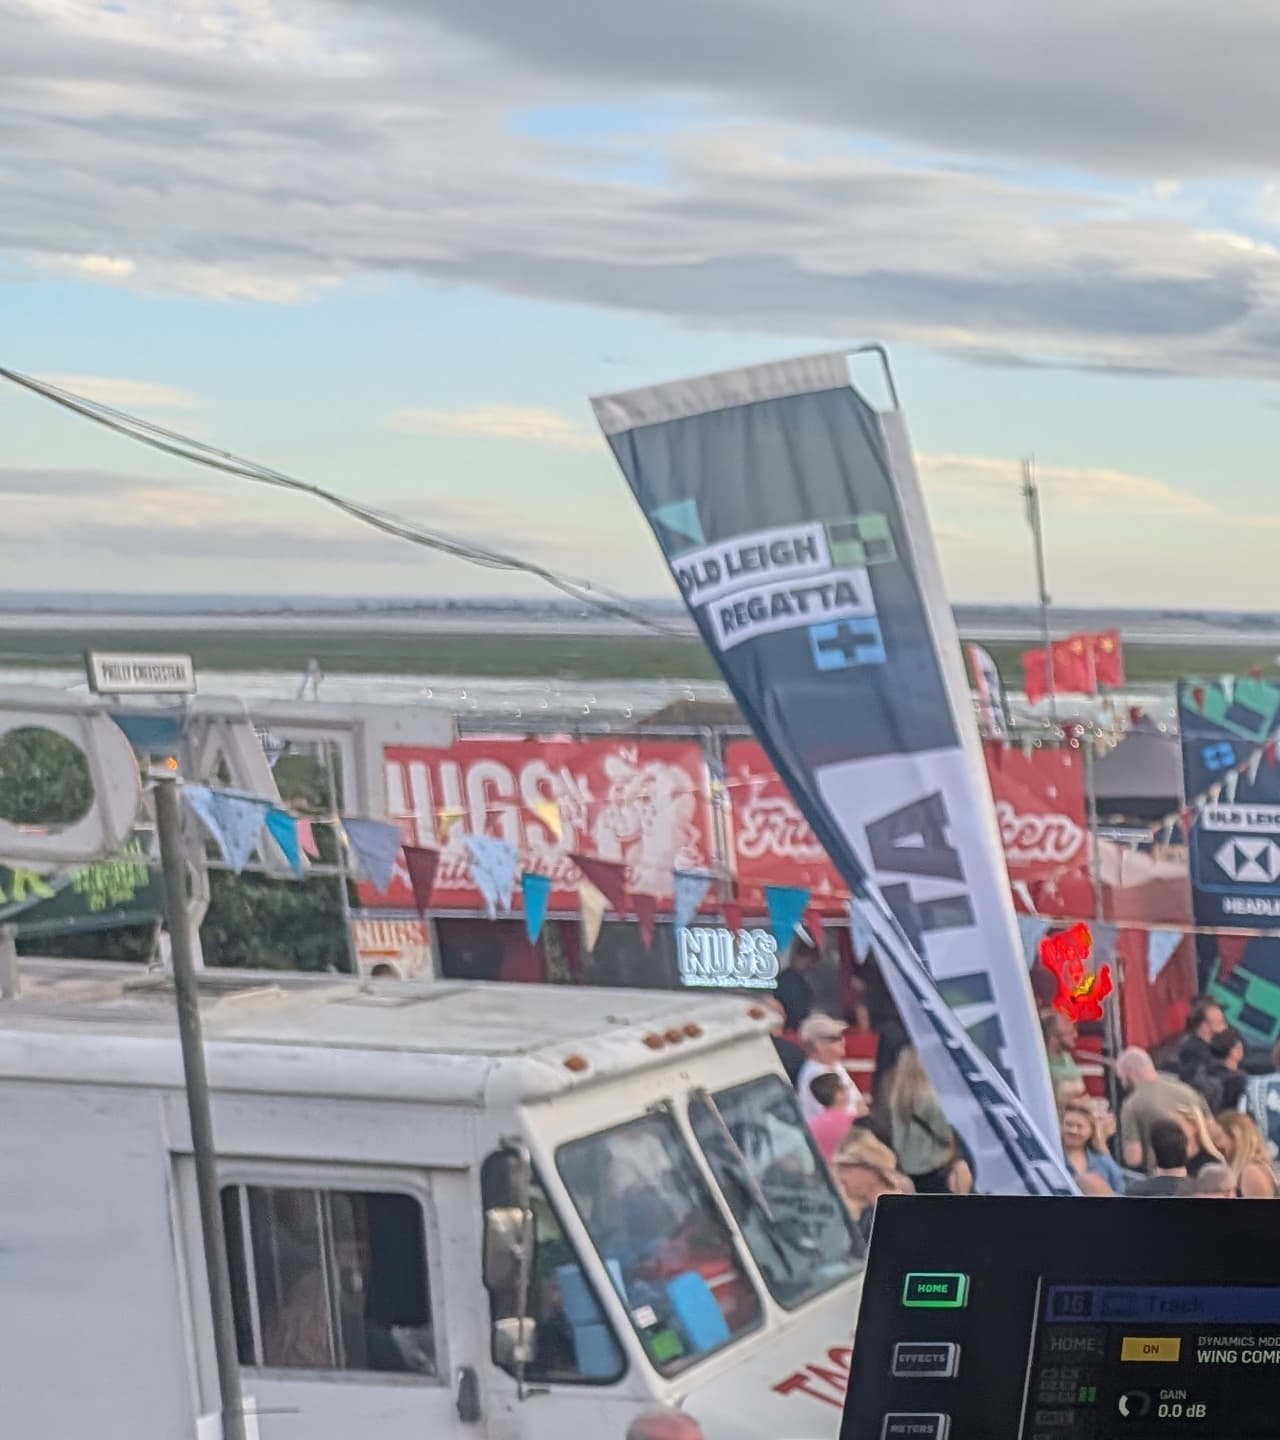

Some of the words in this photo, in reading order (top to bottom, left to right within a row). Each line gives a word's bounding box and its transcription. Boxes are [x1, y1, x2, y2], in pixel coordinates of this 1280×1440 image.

[679, 555, 724, 594] OLD
[725, 534, 818, 577] LEIGH
[718, 578, 859, 634] REGATTA
[1210, 813, 1241, 823] OLD
[677, 927, 780, 980] NUGS
[917, 1283, 949, 1294] HOME
[1050, 1337, 1096, 1352] HOME
[1198, 1336, 1250, 1347] DYNAMICS
[1142, 1344, 1160, 1355] ON
[898, 1352, 946, 1364] EFFECTS
[1196, 1350, 1237, 1365] WING
[1159, 1390, 1186, 1400] GAIN
[1158, 1404, 1182, 1418] 0.0
[1186, 1404, 1206, 1418] dB
[890, 1424, 934, 1434] METERS
